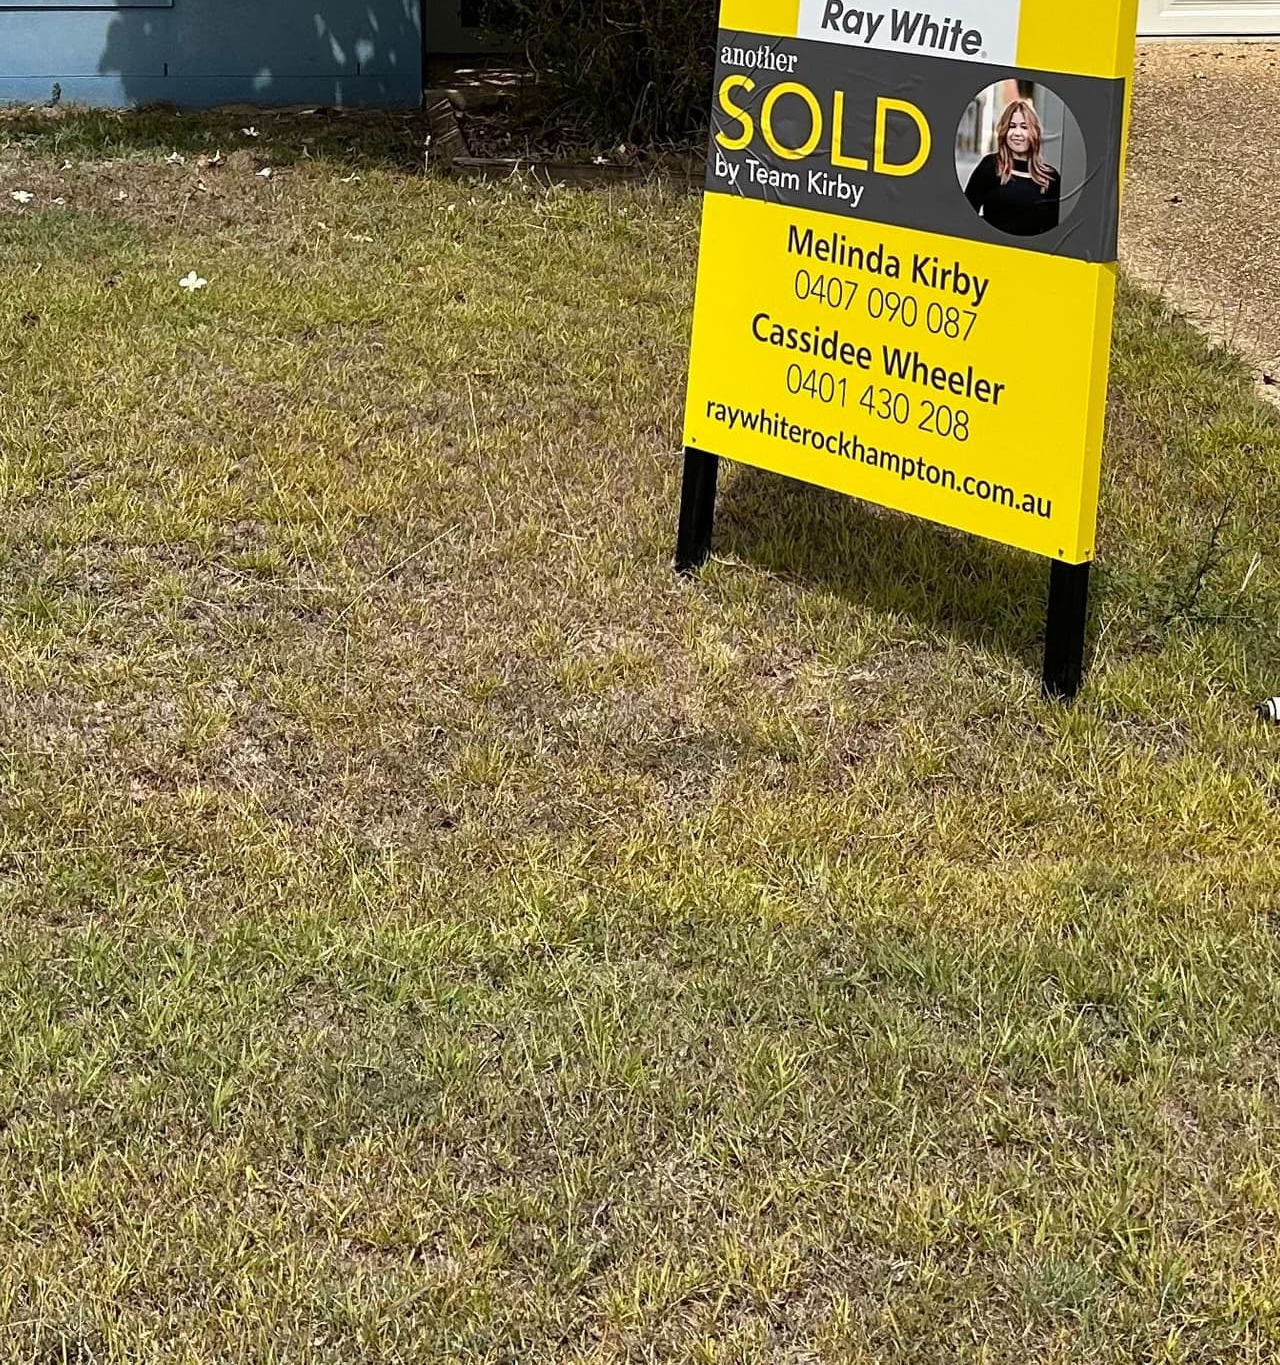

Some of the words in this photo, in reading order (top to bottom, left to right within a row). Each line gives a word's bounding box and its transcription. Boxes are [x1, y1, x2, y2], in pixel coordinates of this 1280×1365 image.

[720, 46, 798, 72] another
[891, 9, 983, 55] White
[714, 74, 932, 177] SOLD
[714, 153, 740, 183] by
[746, 161, 800, 191] Team
[807, 171, 864, 208] Kirby
[787, 224, 901, 279] Melinda
[912, 253, 990, 306] Kirby
[794, 269, 858, 312] 0407
[867, 287, 918, 327] 090
[926, 302, 977, 341] 087
[751, 312, 872, 369] Cassidee
[883, 345, 1006, 406] Wheeler
[786, 363, 849, 407] 0401
[859, 385, 910, 424] 430
[918, 400, 970, 442] 208
[706, 399, 1052, 519] raywhiterockhampton.com.au
